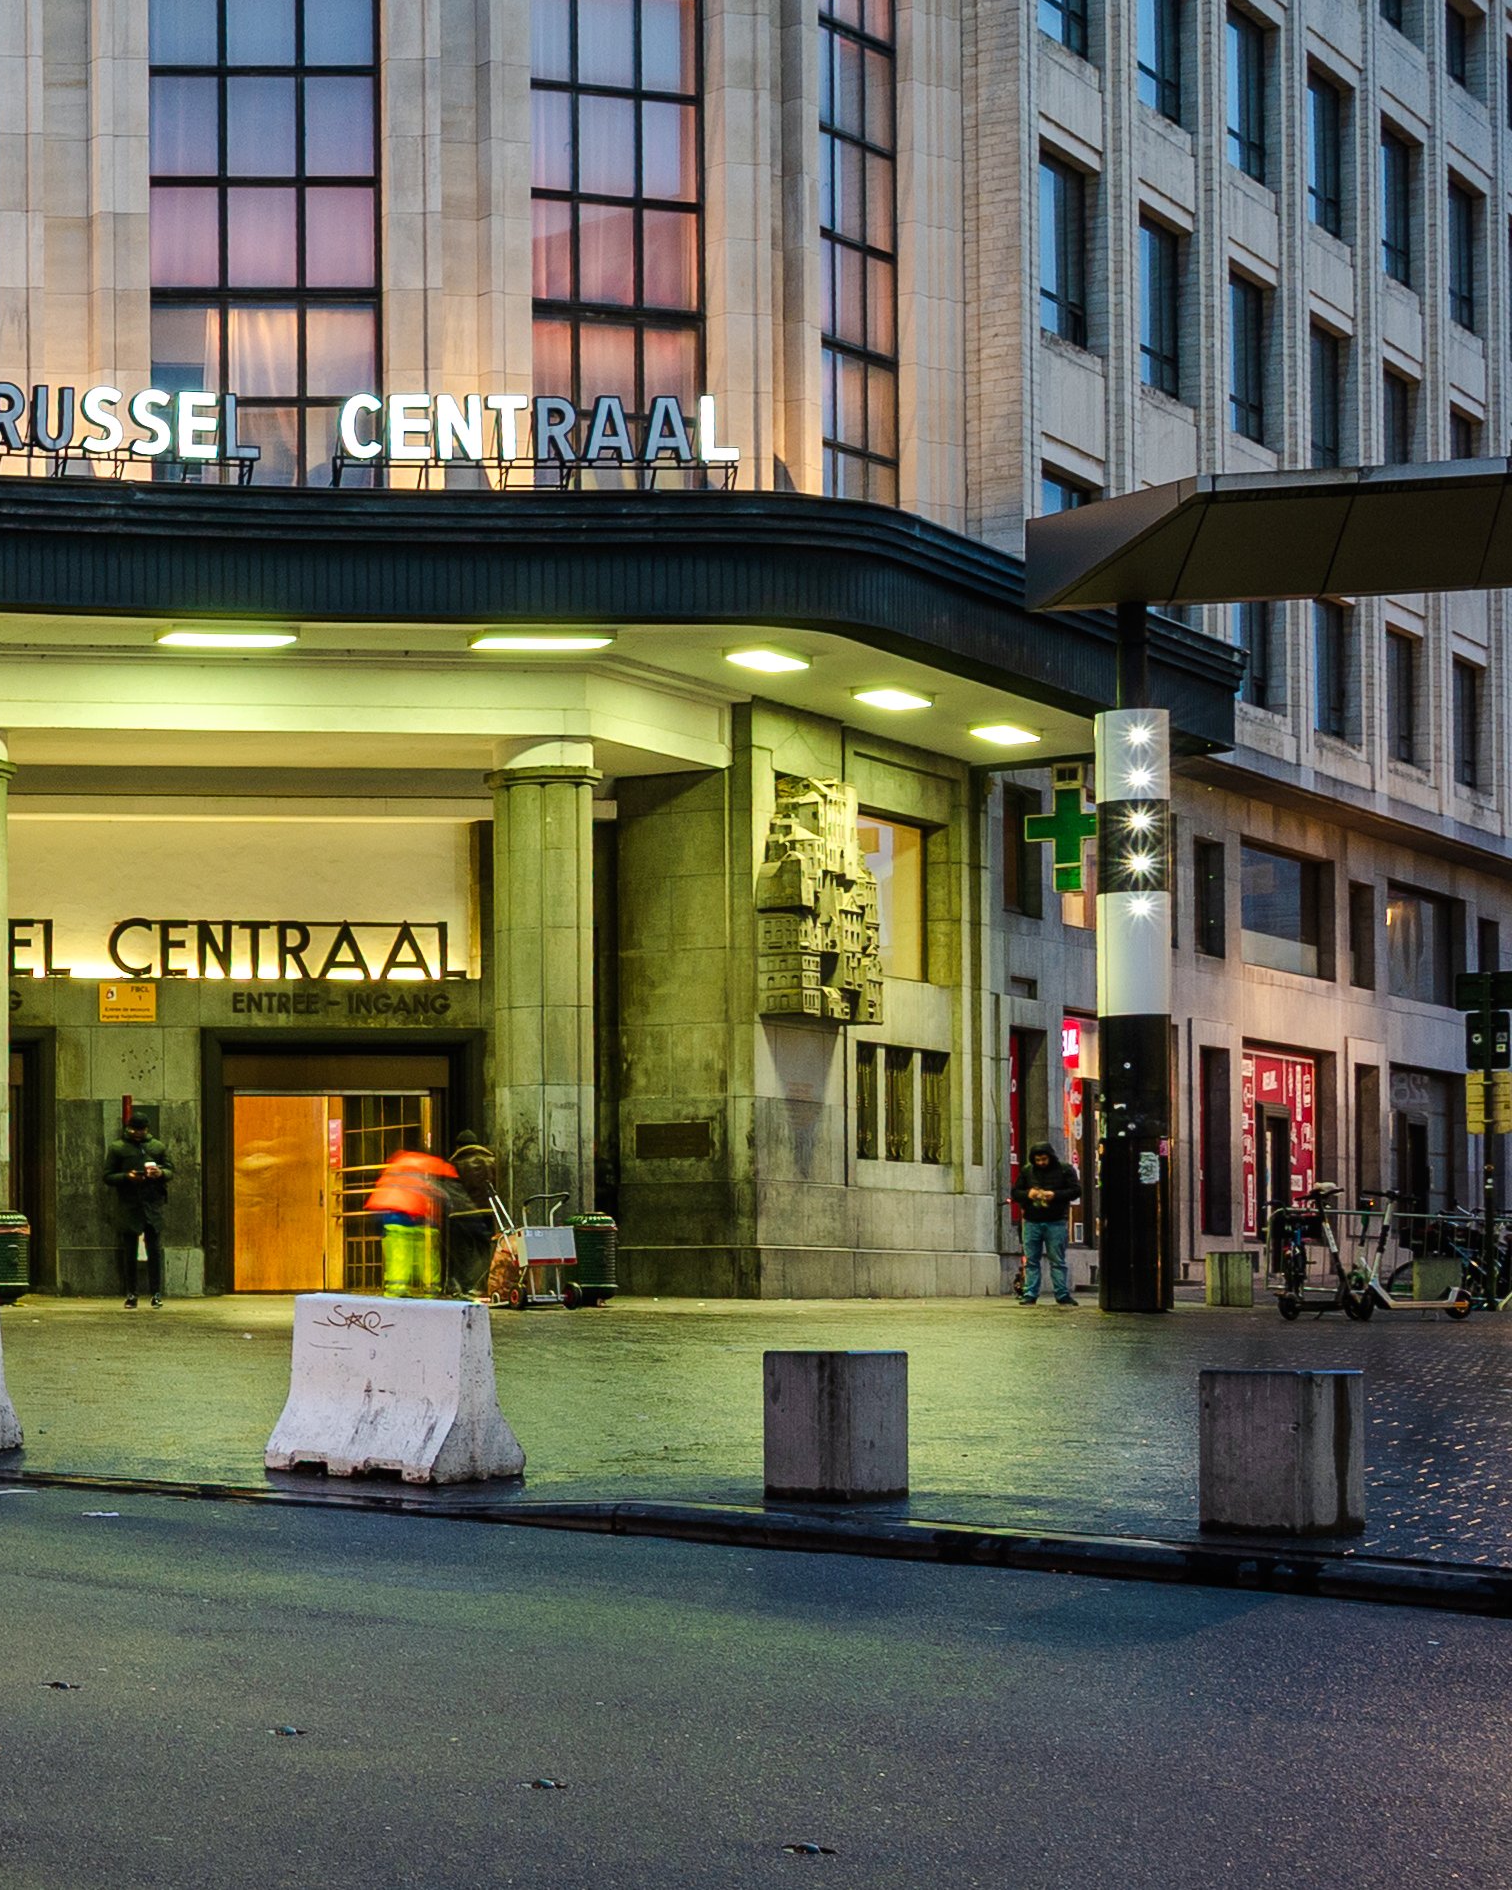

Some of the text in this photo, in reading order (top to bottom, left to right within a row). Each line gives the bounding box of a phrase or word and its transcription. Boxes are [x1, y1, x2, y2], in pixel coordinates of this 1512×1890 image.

[338, 393, 740, 462] CENTRAAL
[109, 917, 466, 979] CENTRAAL
[232, 992, 320, 1014] ENTREE
[348, 992, 451, 1015] INGANG
